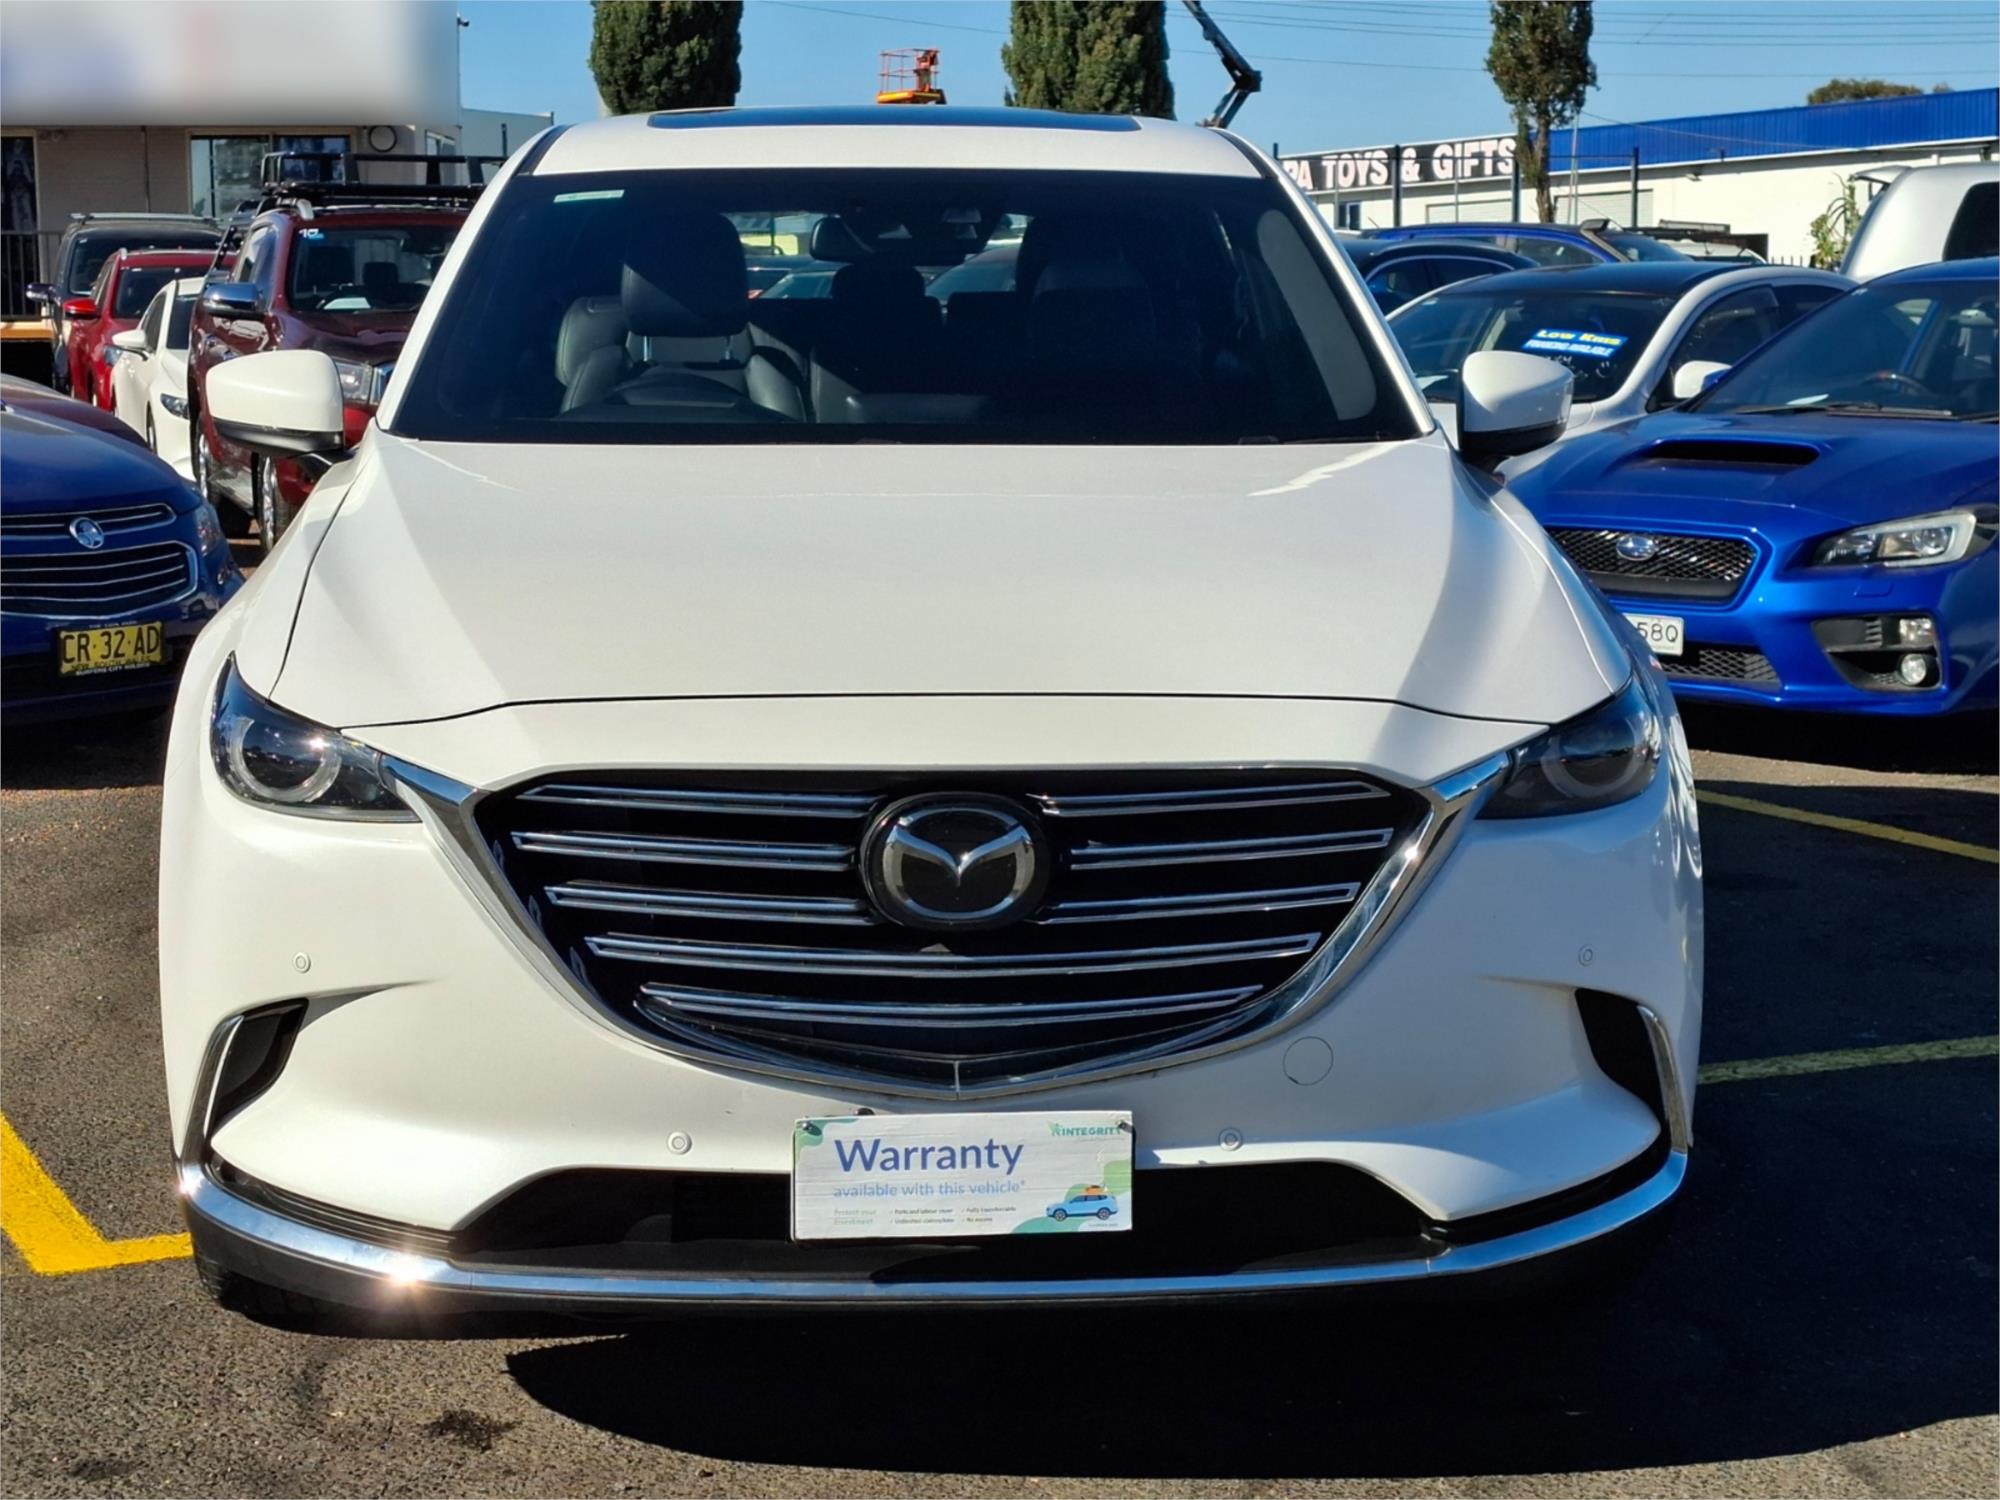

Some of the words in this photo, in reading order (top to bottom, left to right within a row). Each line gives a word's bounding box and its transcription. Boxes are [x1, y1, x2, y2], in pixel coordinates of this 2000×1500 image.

[1322, 150, 1389, 189] TOYS
[1402, 147, 1421, 182] &
[1432, 137, 1517, 180] GIFTS
[834, 1138, 1024, 1176] Warranty
[833, 1182, 897, 1198] available
[902, 1182, 934, 1196] with
[938, 1181, 965, 1195] this
